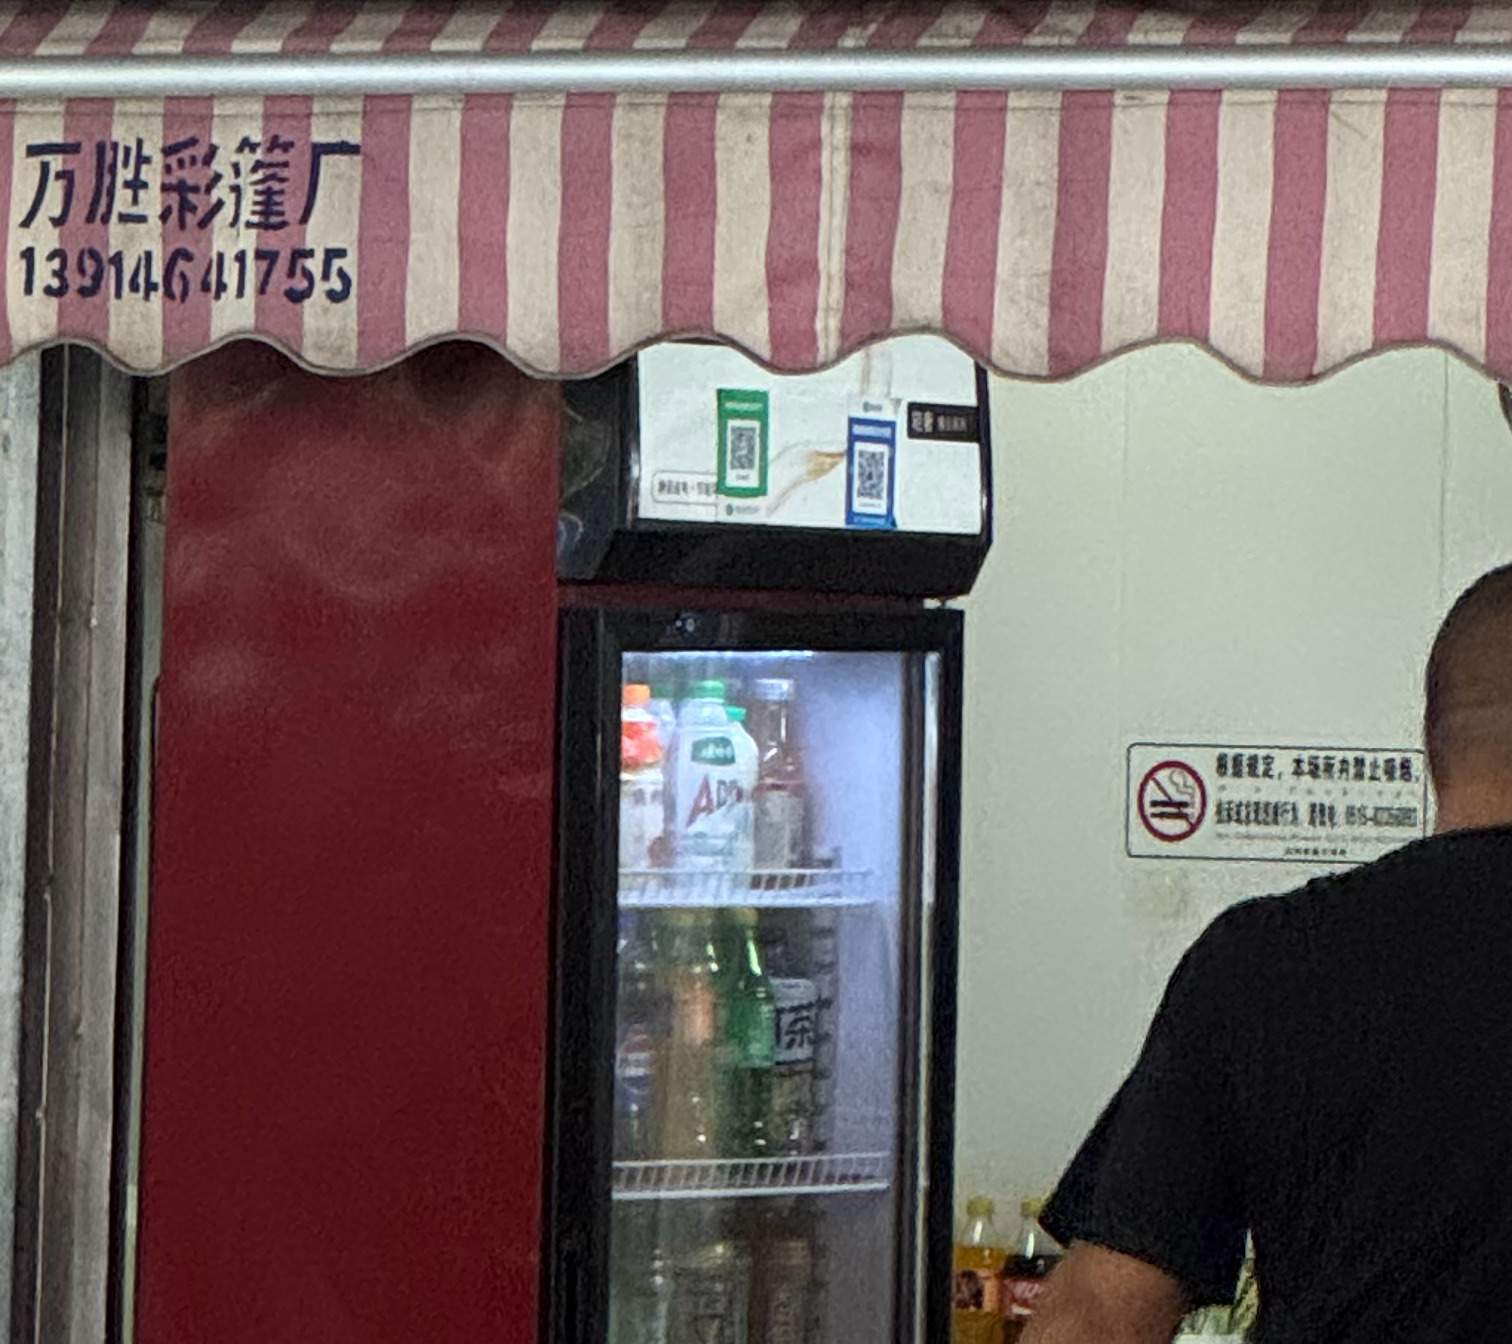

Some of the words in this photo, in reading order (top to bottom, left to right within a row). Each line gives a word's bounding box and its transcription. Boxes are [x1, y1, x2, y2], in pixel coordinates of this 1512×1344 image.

[18, 135, 362, 230] 万胜彩篷厂
[19, 246, 353, 304] 13914641755
